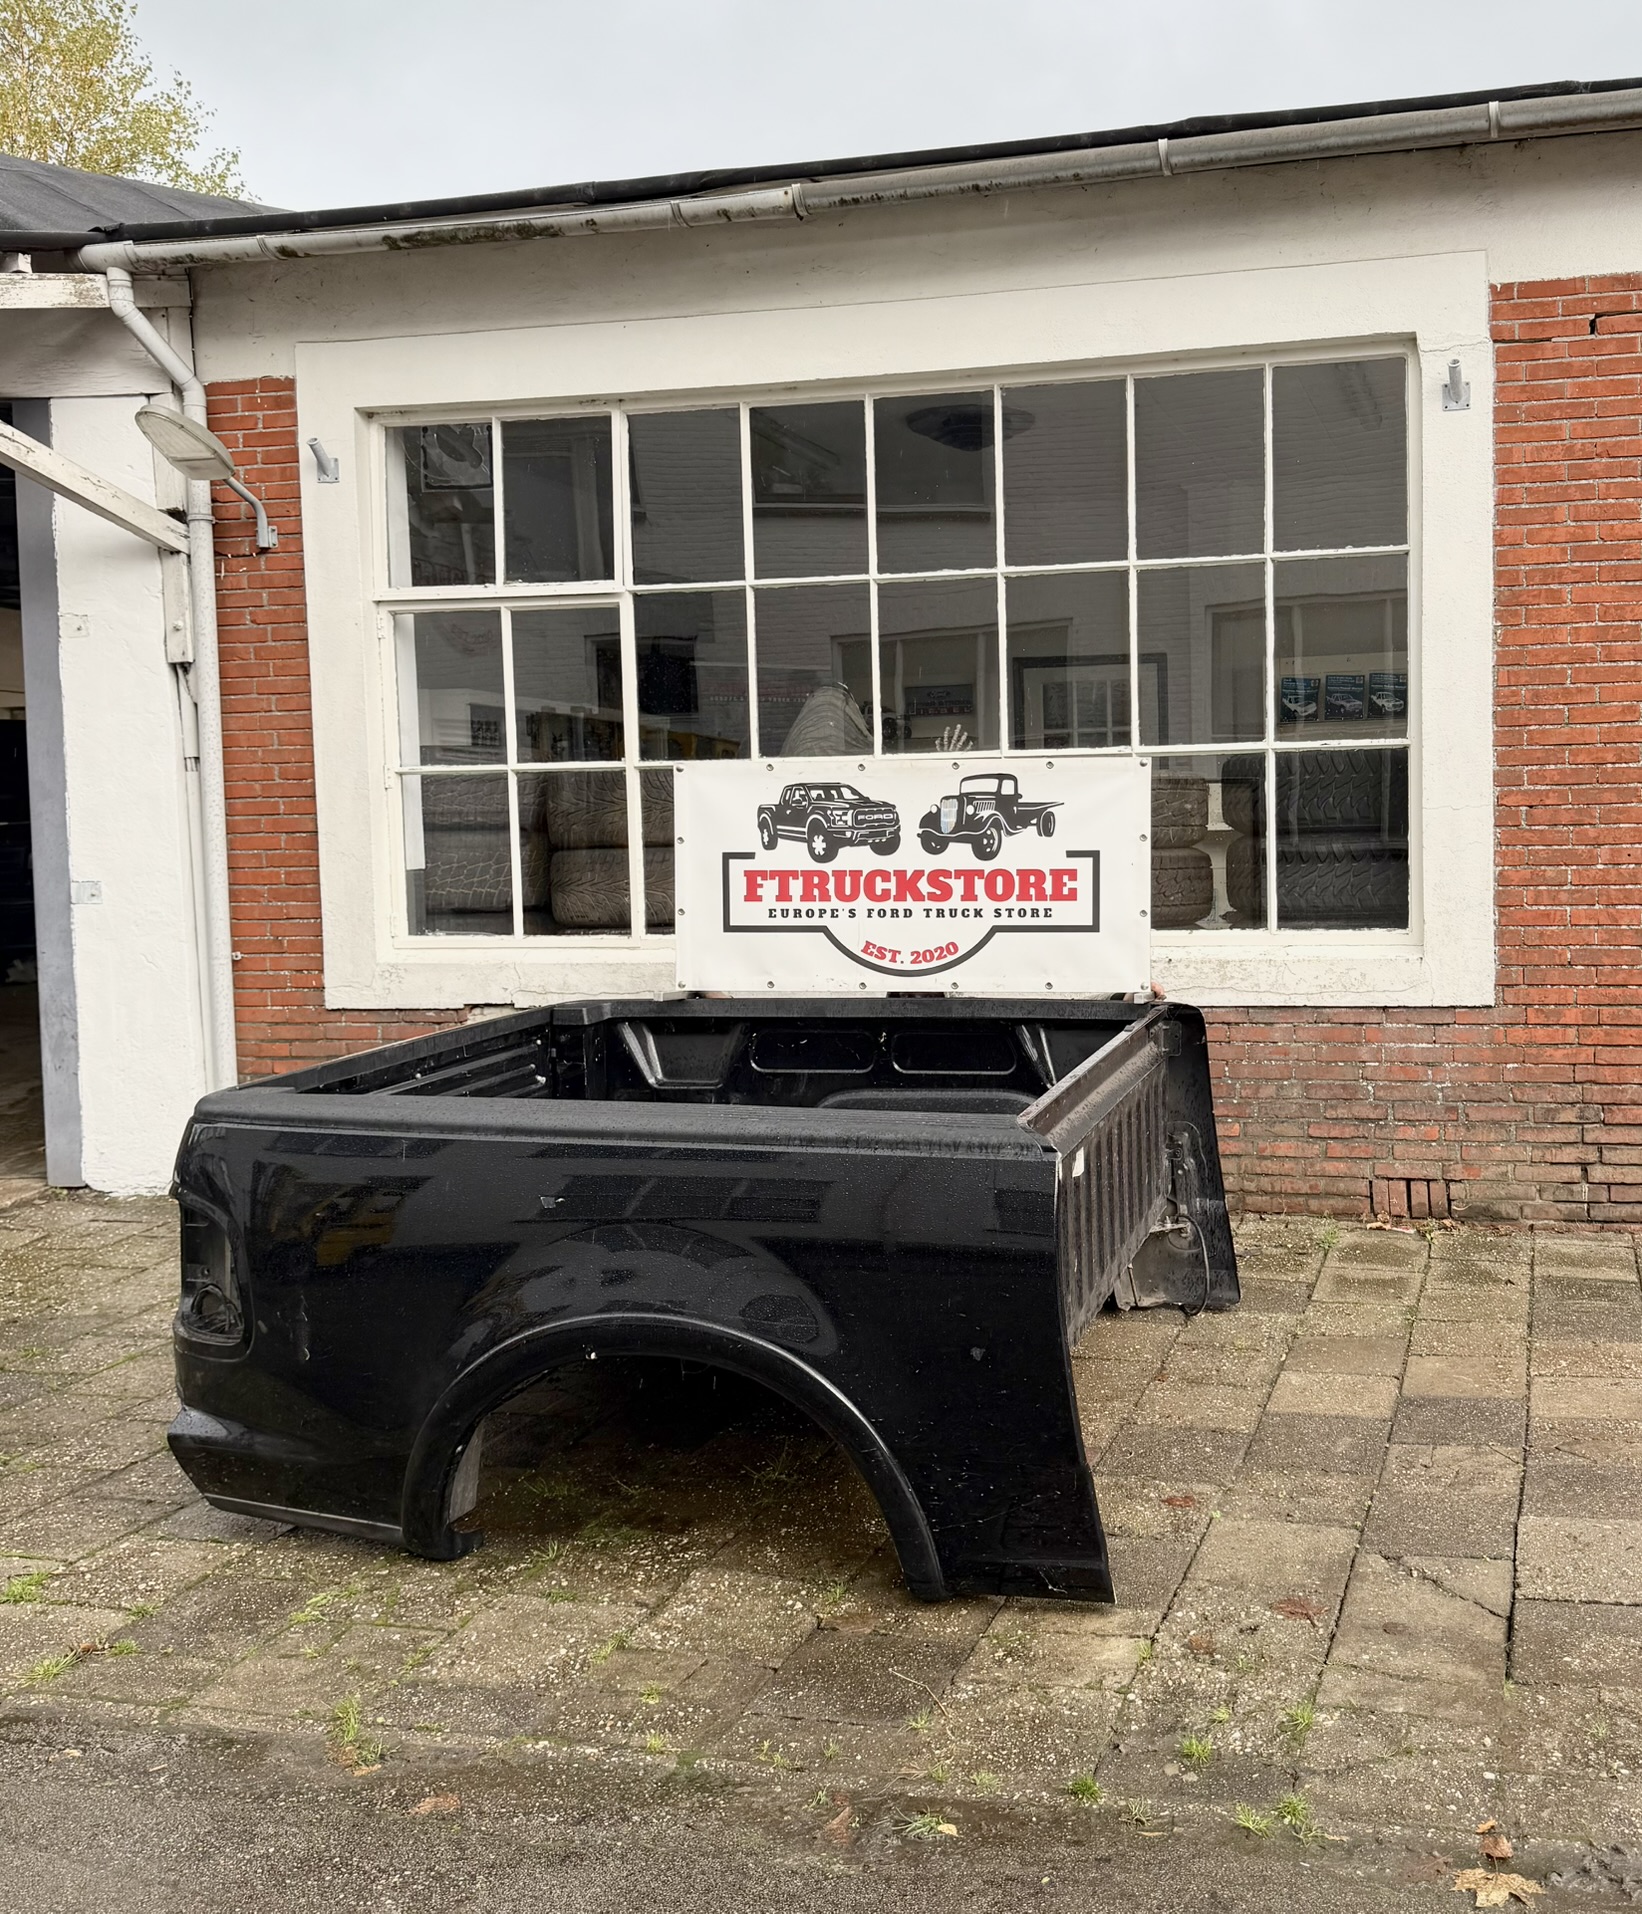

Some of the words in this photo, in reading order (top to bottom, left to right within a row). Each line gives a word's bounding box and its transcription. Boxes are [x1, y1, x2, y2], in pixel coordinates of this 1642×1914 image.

[743, 869, 1078, 903] FTRUCKSTORE
[768, 908, 857, 919] EUROPE'S
[867, 908, 913, 919] FORD
[924, 908, 984, 919] TRUCK
[993, 907, 1053, 918] STORE
[861, 941, 904, 964] EST.
[910, 941, 959, 965] 2020
